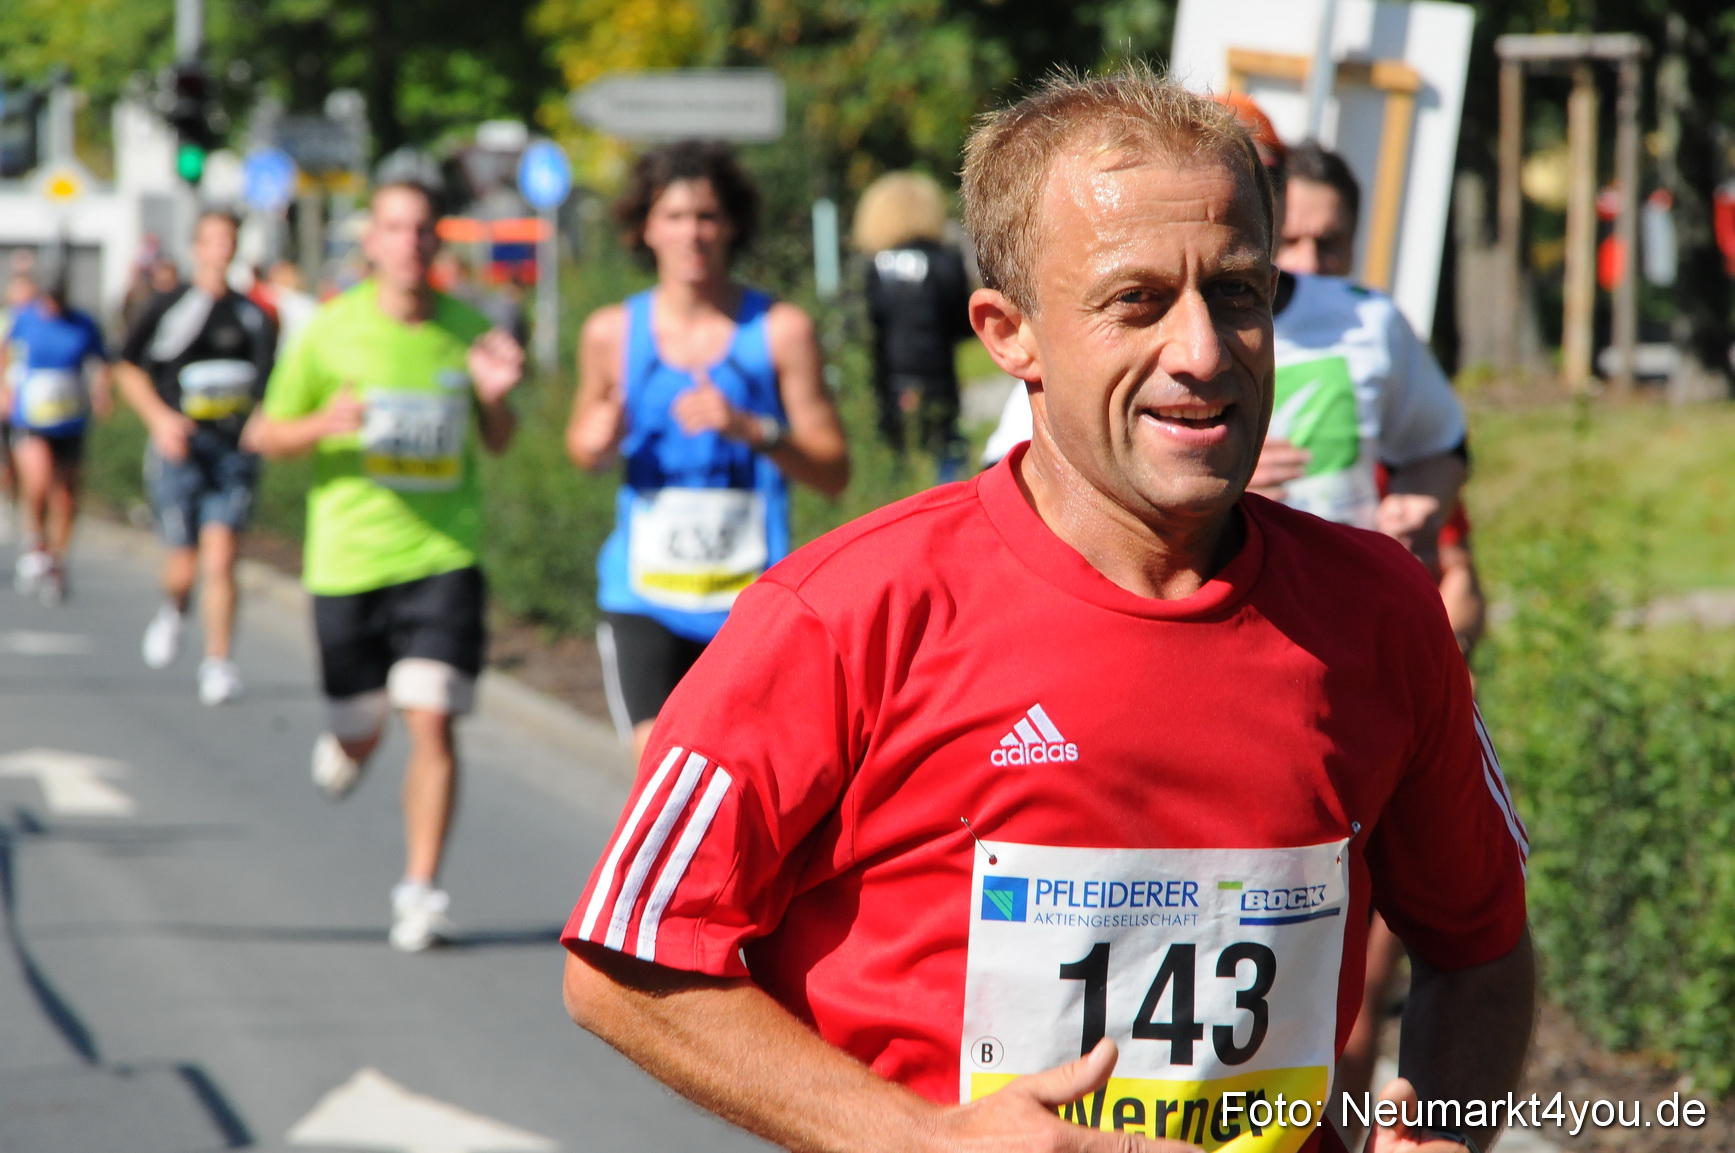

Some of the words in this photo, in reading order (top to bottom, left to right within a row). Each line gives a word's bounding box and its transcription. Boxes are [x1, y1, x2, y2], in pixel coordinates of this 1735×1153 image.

[990, 741, 1079, 767] adidas
[1034, 878, 1199, 908] PFLEIDERER
[1240, 884, 1327, 912] BOCK
[1033, 912, 1200, 929] AKTIENGESELLSCHAFT
[1058, 941, 1278, 1067] 143
[981, 1043, 993, 1064] B
